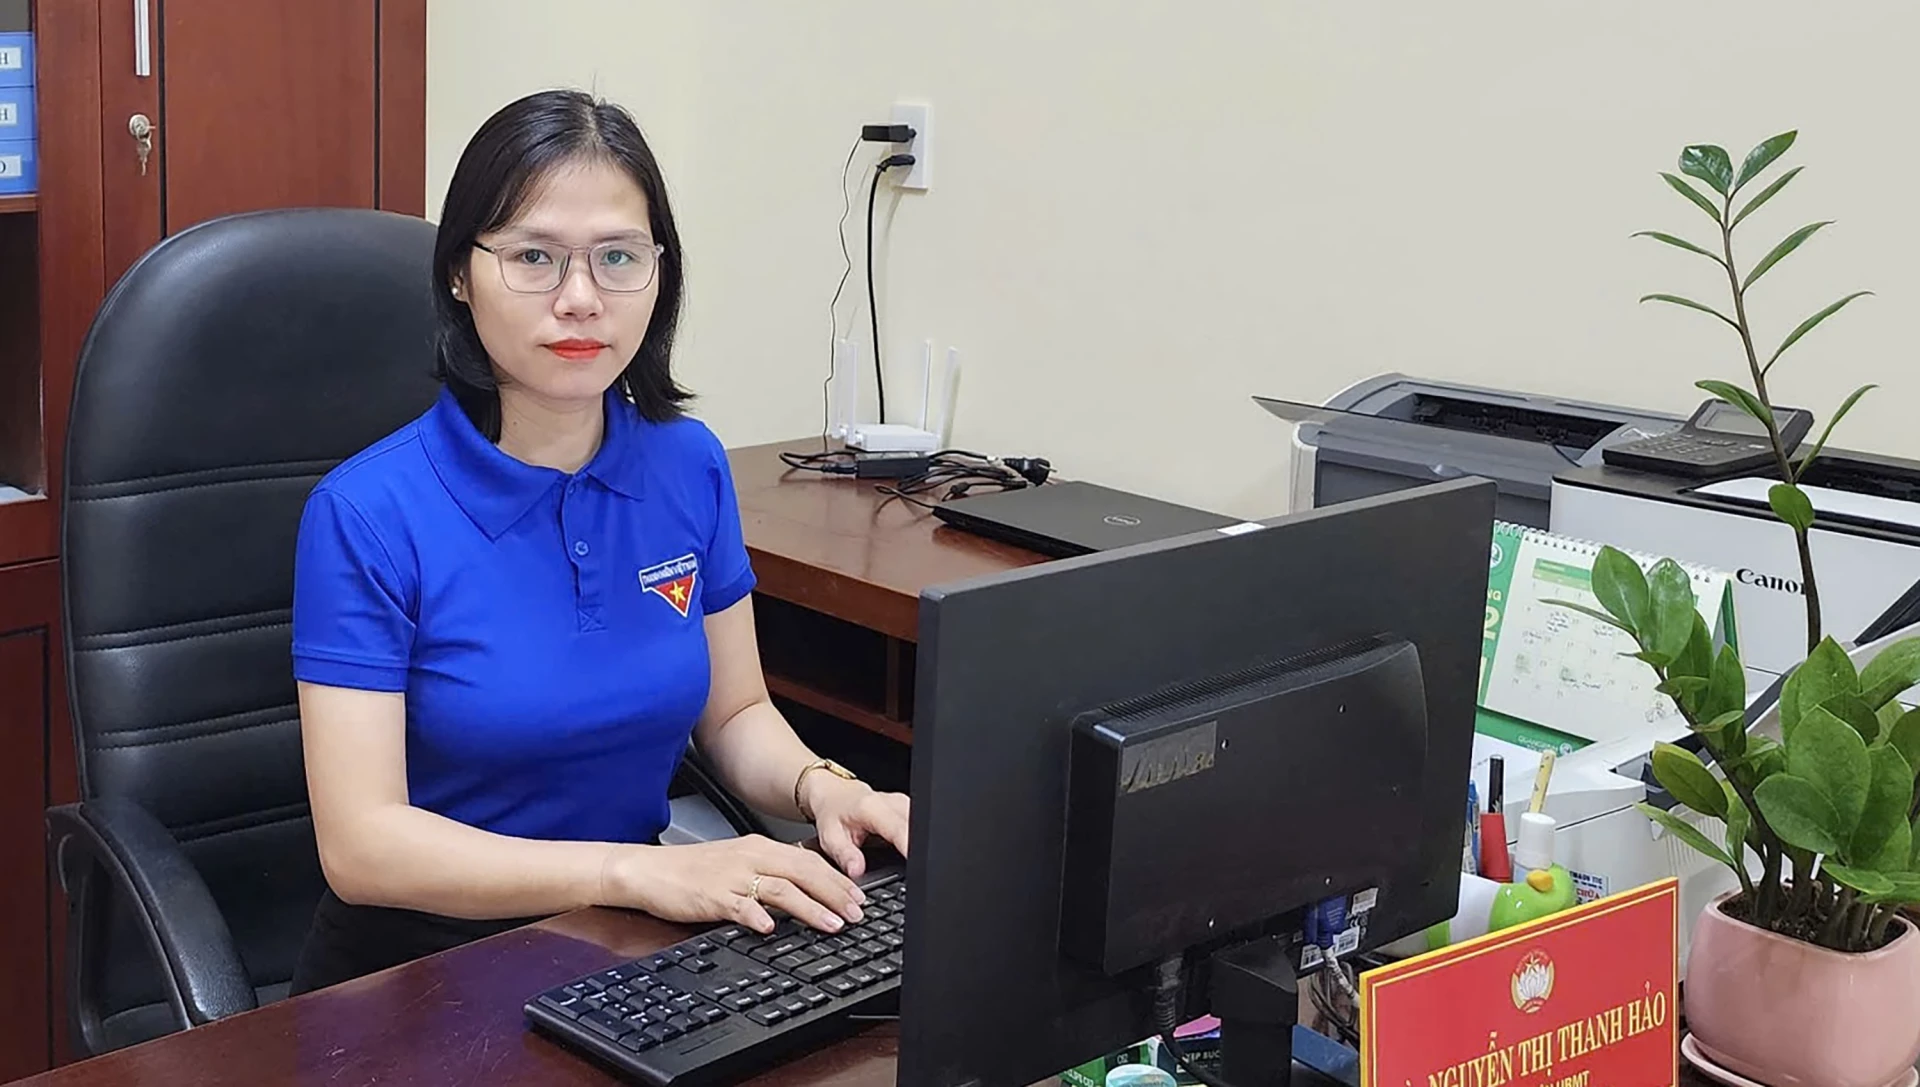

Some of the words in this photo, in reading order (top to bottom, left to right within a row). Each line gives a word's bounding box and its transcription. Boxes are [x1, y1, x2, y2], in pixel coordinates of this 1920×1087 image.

[1518, 1032, 1553, 1077] THỊ
[1557, 1006, 1624, 1062] THANH
[1628, 980, 1666, 1037] HẢO
